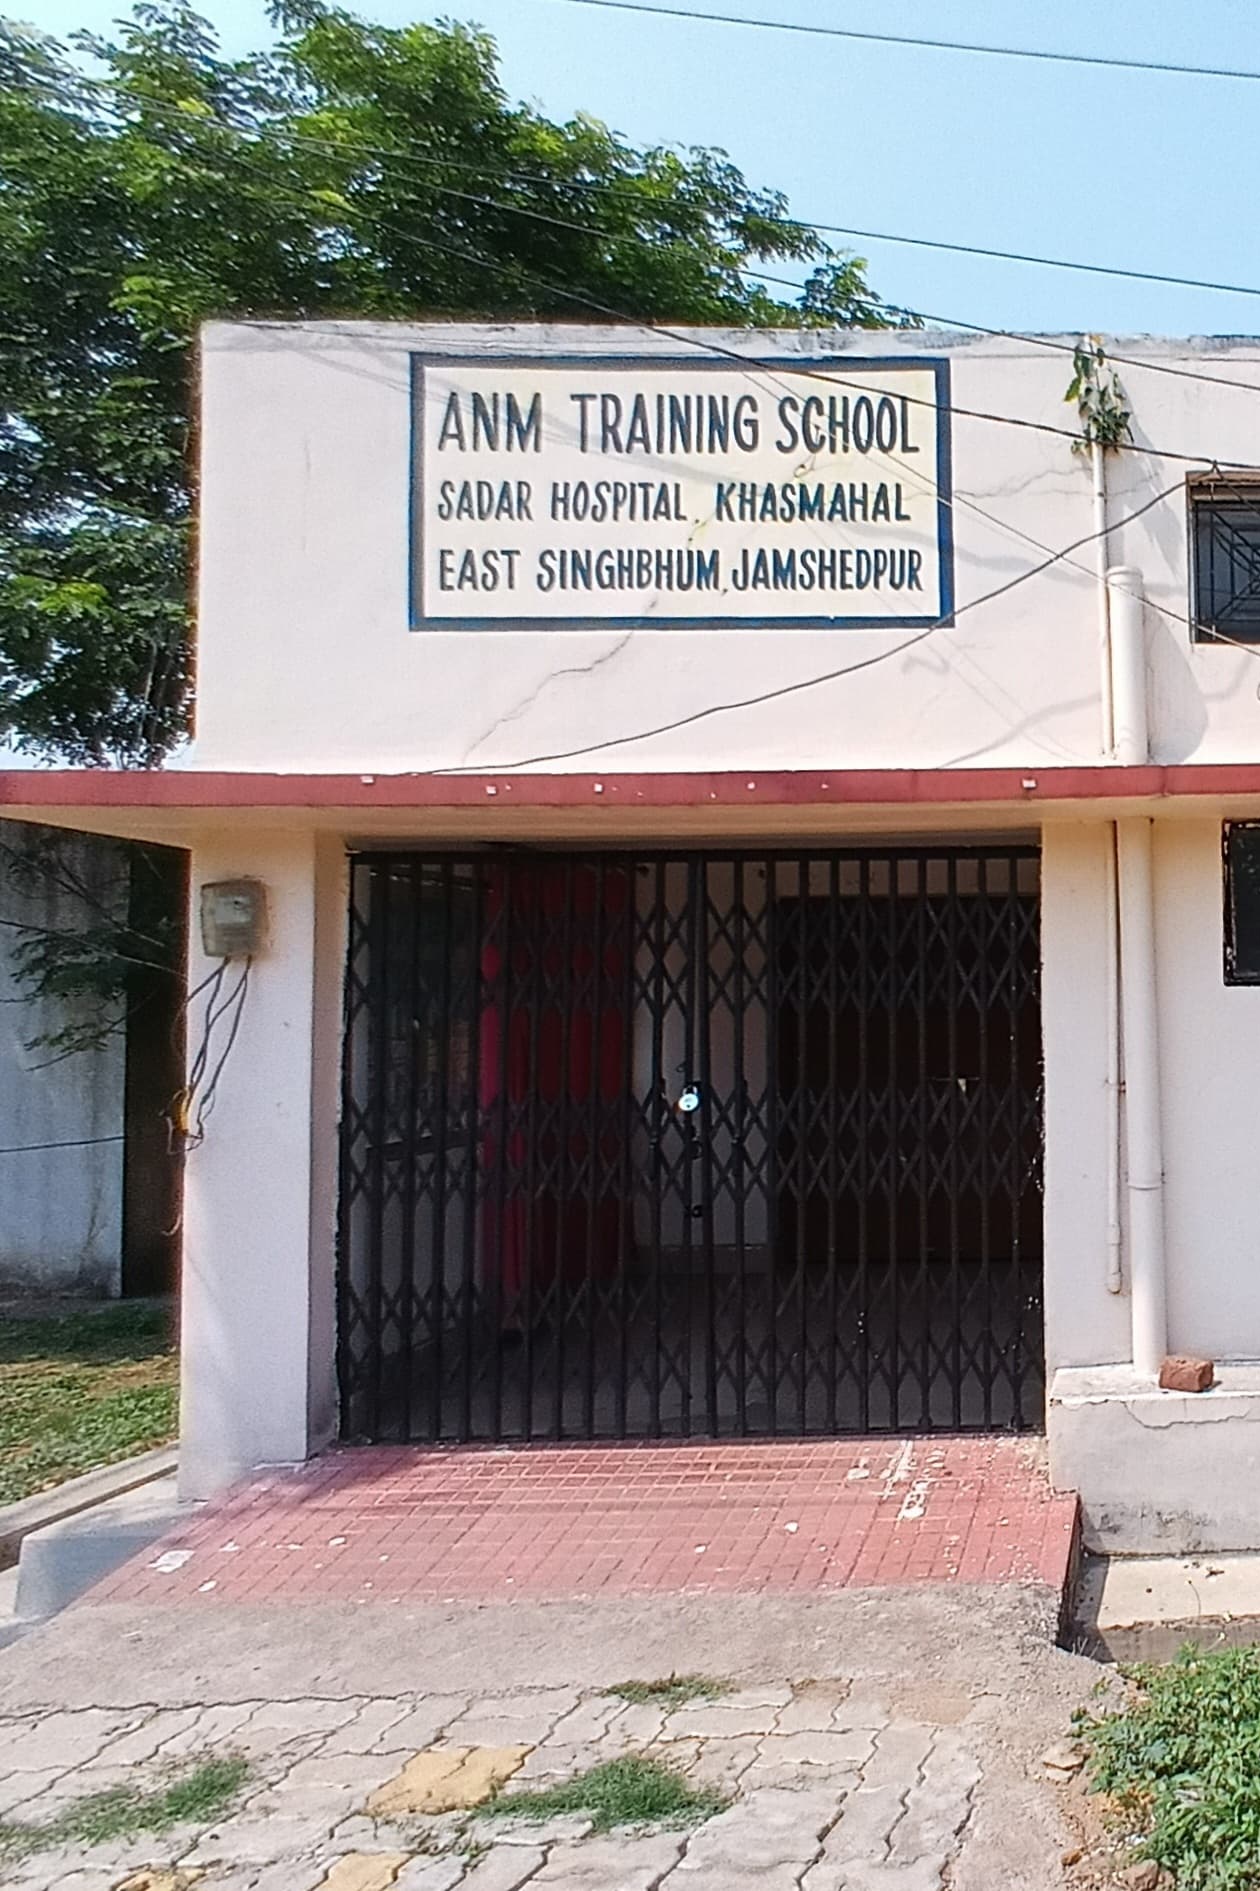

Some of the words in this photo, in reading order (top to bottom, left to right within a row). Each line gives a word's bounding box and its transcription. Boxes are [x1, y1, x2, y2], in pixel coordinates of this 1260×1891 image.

[438, 391, 542, 453] ANM
[571, 394, 760, 454] TRAINING
[775, 395, 920, 455] SCHOOL
[438, 480, 533, 521] SADAR
[716, 482, 911, 522] KHASMAHAL
[439, 549, 521, 592] EAST
[731, 549, 924, 592] JAMSHEDPUR
